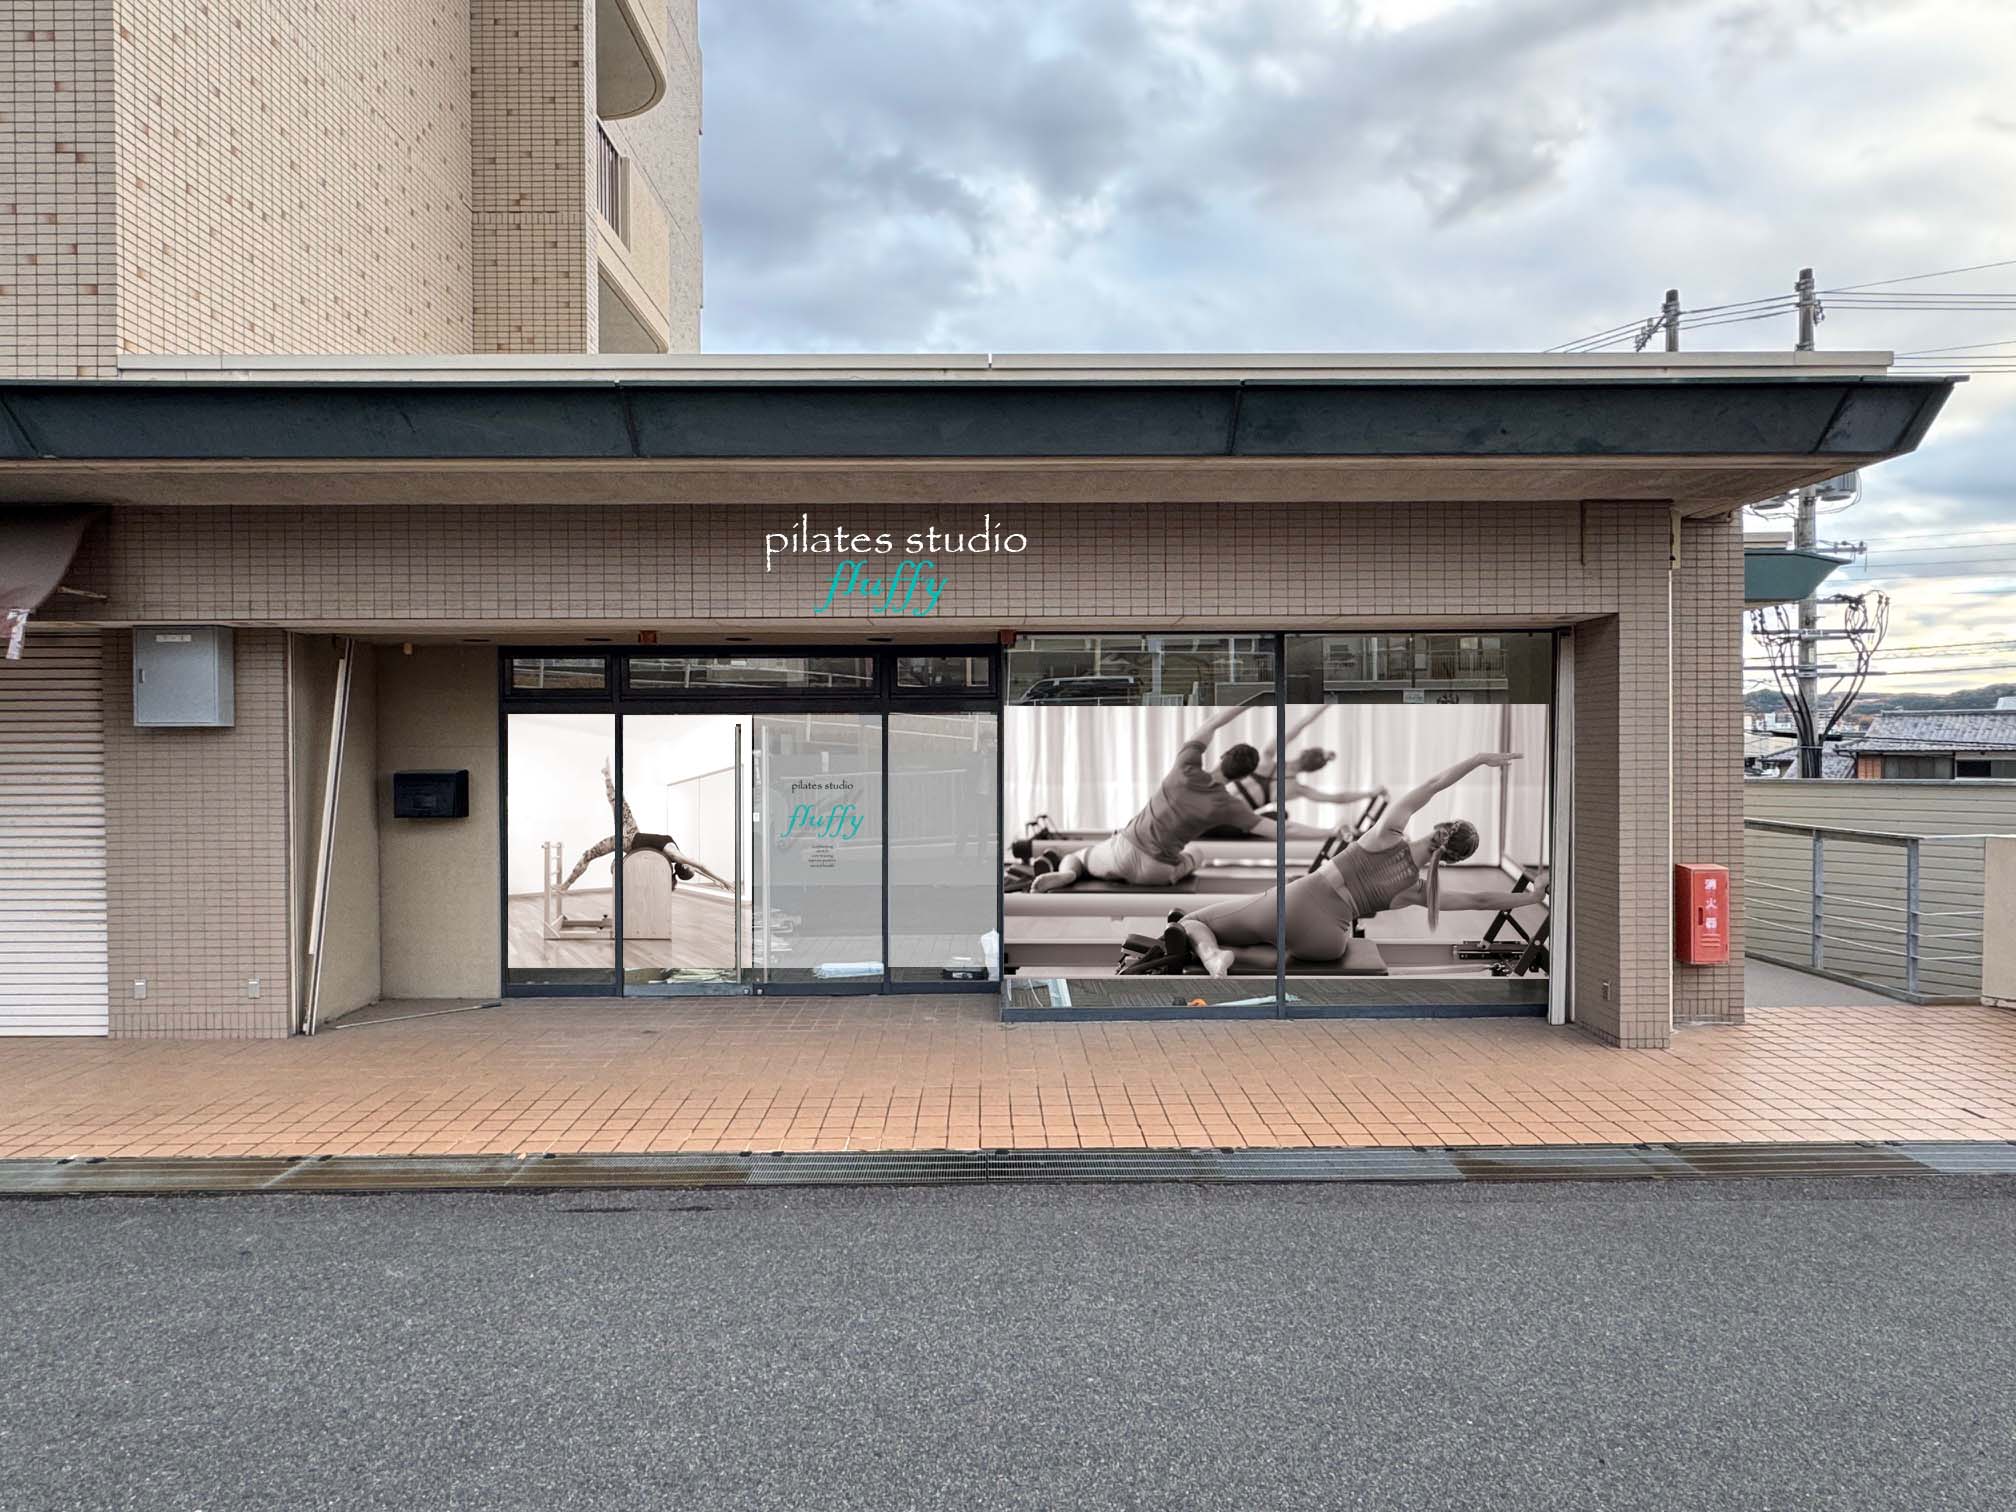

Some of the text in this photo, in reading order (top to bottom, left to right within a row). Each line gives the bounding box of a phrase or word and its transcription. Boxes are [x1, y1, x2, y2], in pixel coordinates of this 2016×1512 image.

[765, 513, 1027, 572] pilates studio
[812, 559, 949, 616] fluffy
[791, 779, 854, 794] pilates studio
[780, 803, 865, 840] fluffy
